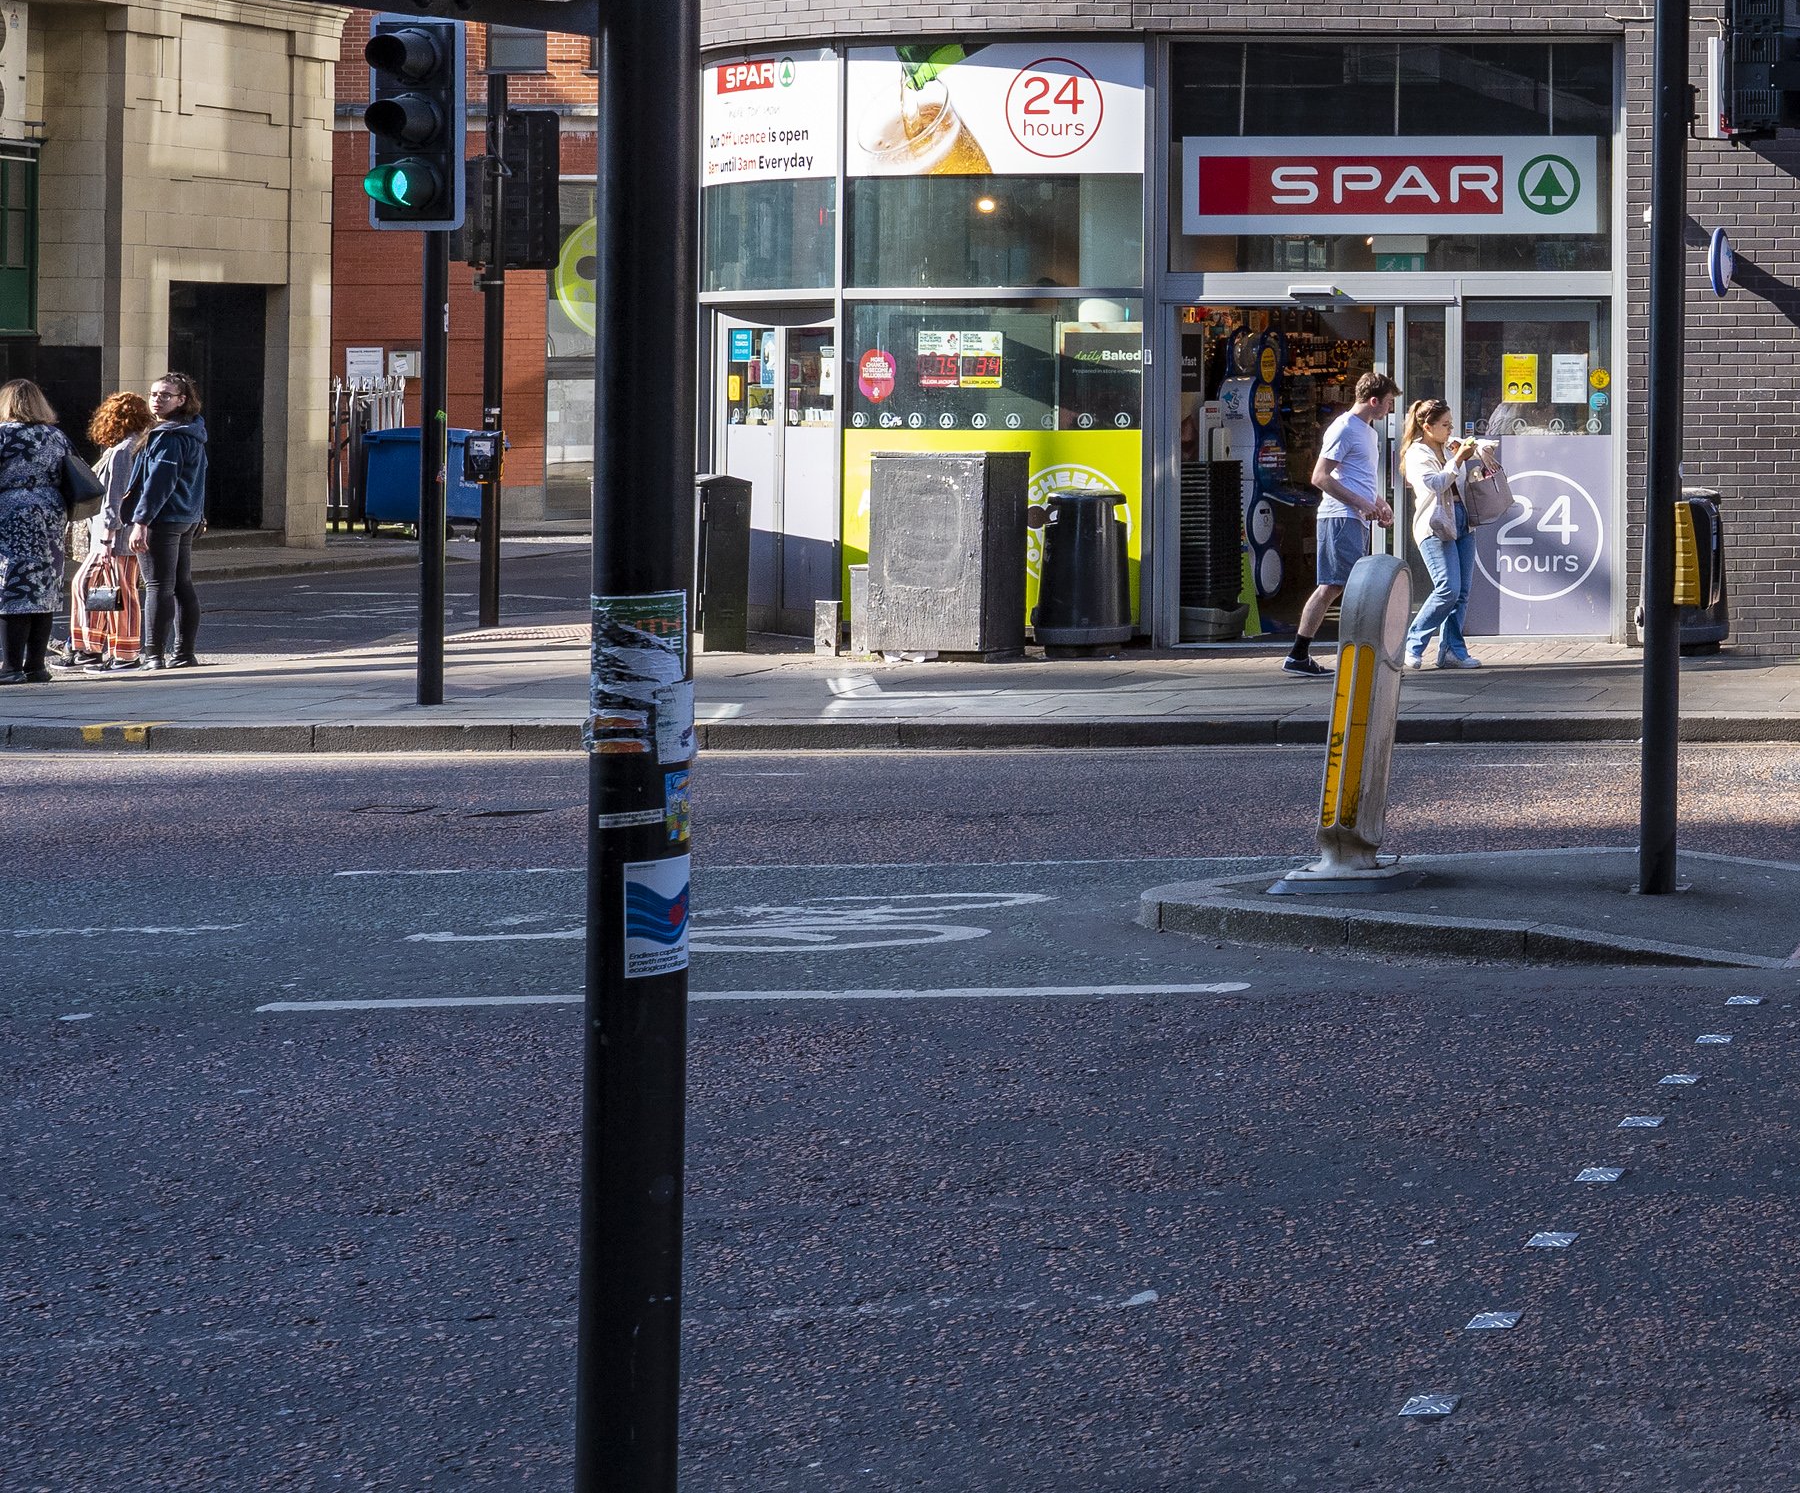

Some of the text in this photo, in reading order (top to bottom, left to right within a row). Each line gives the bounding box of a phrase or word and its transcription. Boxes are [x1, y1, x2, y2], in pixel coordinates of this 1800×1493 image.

[725, 63, 774, 89] SPAR
[1023, 76, 1085, 115] 24
[720, 131, 732, 147] Off
[733, 131, 766, 146] Licence
[768, 126, 777, 143] is
[779, 129, 809, 146] open
[1023, 119, 1085, 136] hours
[720, 155, 737, 173] until
[737, 156, 757, 171] 3am
[759, 152, 814, 172] Everyday
[1270, 165, 1499, 205] SPAR
[976, 357, 999, 376] 34
[1030, 471, 1113, 503] CHEEK
[1496, 494, 1579, 546] 24
[1496, 549, 1579, 573] hours
[629, 955, 678, 968] growth means
[629, 963, 667, 973] ecological
